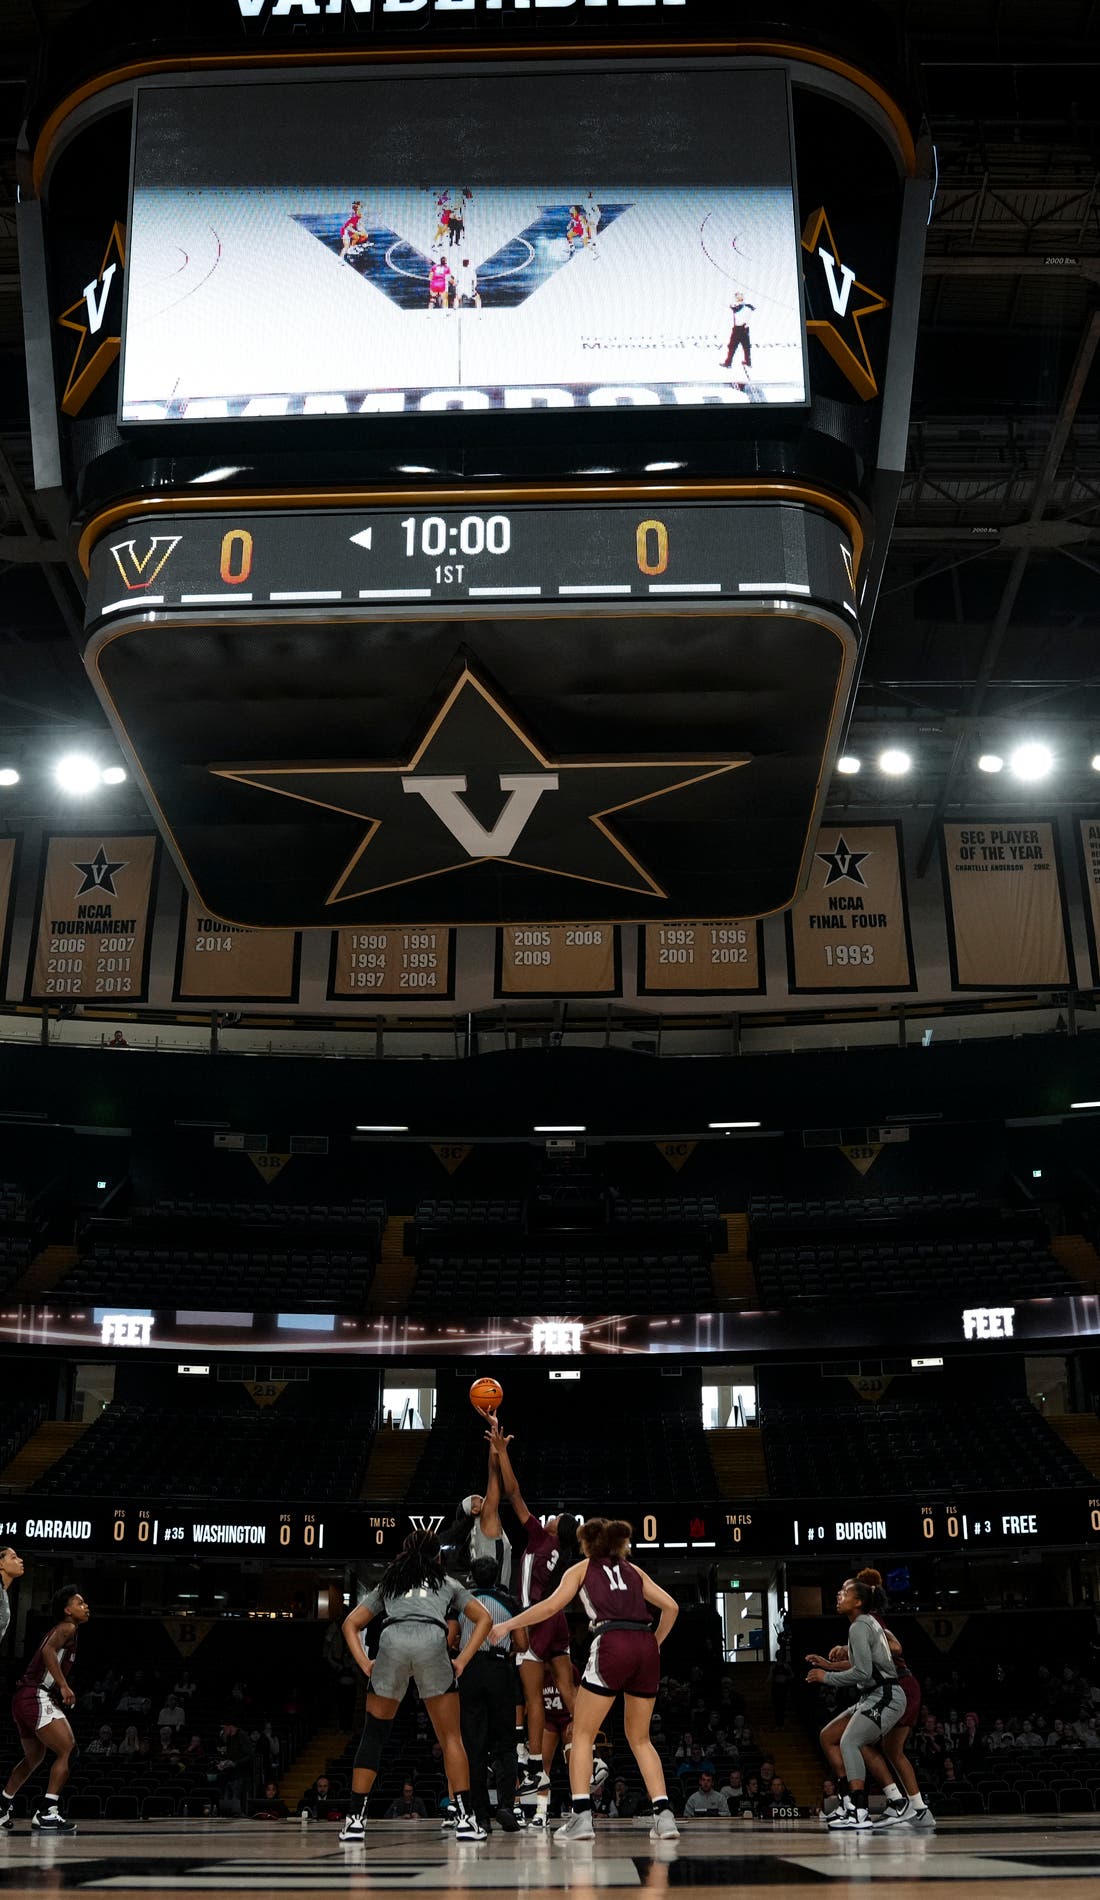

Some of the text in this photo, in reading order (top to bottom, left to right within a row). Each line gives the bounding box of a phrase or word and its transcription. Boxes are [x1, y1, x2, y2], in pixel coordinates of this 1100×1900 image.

[819, 247, 856, 317] V
[83, 263, 116, 334] V
[401, 515, 511, 557] 10:00
[636, 519, 669, 576] 0
[220, 529, 253, 585] 0
[435, 565, 465, 584] 1ST
[401, 773, 559, 857] V
[960, 830, 1039, 844] SEC PLAYER
[960, 846, 1043, 860] OF THE YEAR
[77, 904, 112, 918] NCAA
[828, 896, 864, 911] NCAA
[51, 919, 136, 934] TOURNAMENT
[809, 913, 887, 929] FINAL FOUR
[50, 937, 136, 953] 2006 2007
[195, 936, 233, 952] 2014
[351, 934, 437, 949] 1990 1991
[514, 930, 602, 946] 2005 2008
[659, 929, 747, 945] 1992 1996
[351, 953, 438, 968] 1994 1995
[514, 950, 551, 966] 2009
[659, 948, 748, 964] 2001 2002
[824, 944, 875, 966] 1993
[47, 958, 131, 973] 2010 2011
[46, 977, 132, 993] 2012 2013
[349, 972, 437, 987] 1997 2004
[101, 1315, 154, 1346] FEET
[962, 1307, 1015, 1340] FEET
[114, 1510, 150, 1519] PTS FLS
[280, 1514, 315, 1523] PTS FLS
[921, 1507, 933, 1515] PTS
[369, 1517, 396, 1528] TM FLS
[726, 1514, 752, 1525] TM FLS
[923, 1516, 959, 1538] 0 0
[1002, 1515, 1038, 1535] FREE
[25, 1519, 92, 1539] GARRAUD
[113, 1520, 149, 1542] 0 0
[164, 1524, 266, 1544] #35 WASHINGTON
[279, 1525, 315, 1546] 0 0
[643, 1514, 657, 1542] 0
[733, 1527, 742, 1542] 0
[835, 1521, 887, 1541] BURGIN
[375, 1530, 384, 1545] 0
[602, 1564, 628, 1591] 11
